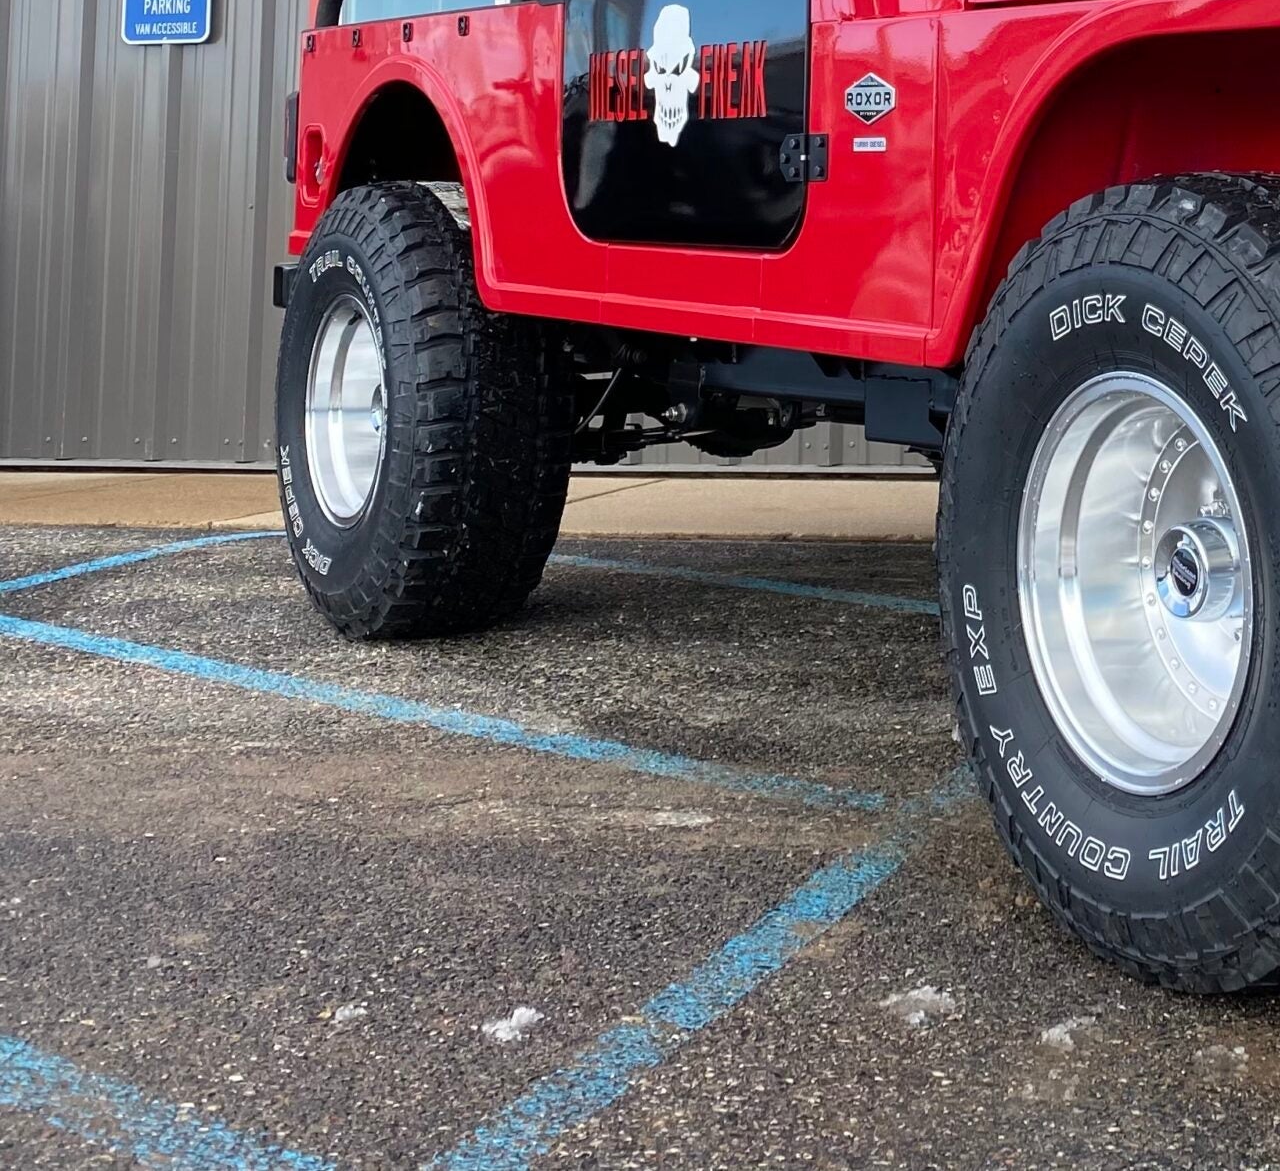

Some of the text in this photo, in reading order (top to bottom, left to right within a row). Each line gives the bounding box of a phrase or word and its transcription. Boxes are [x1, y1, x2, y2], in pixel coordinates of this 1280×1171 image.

[135, 22, 197, 35] VAN ACCESSIBLE
[588, 40, 767, 123] DIESEL FREAK
[846, 92, 892, 107] ROXOR
[309, 250, 343, 283] TRAIL
[1049, 293, 1248, 433] DICK CEPEK
[280, 444, 332, 575] DICK CEPEK
[963, 584, 1246, 880] TRAIL COUNTRY EXP
